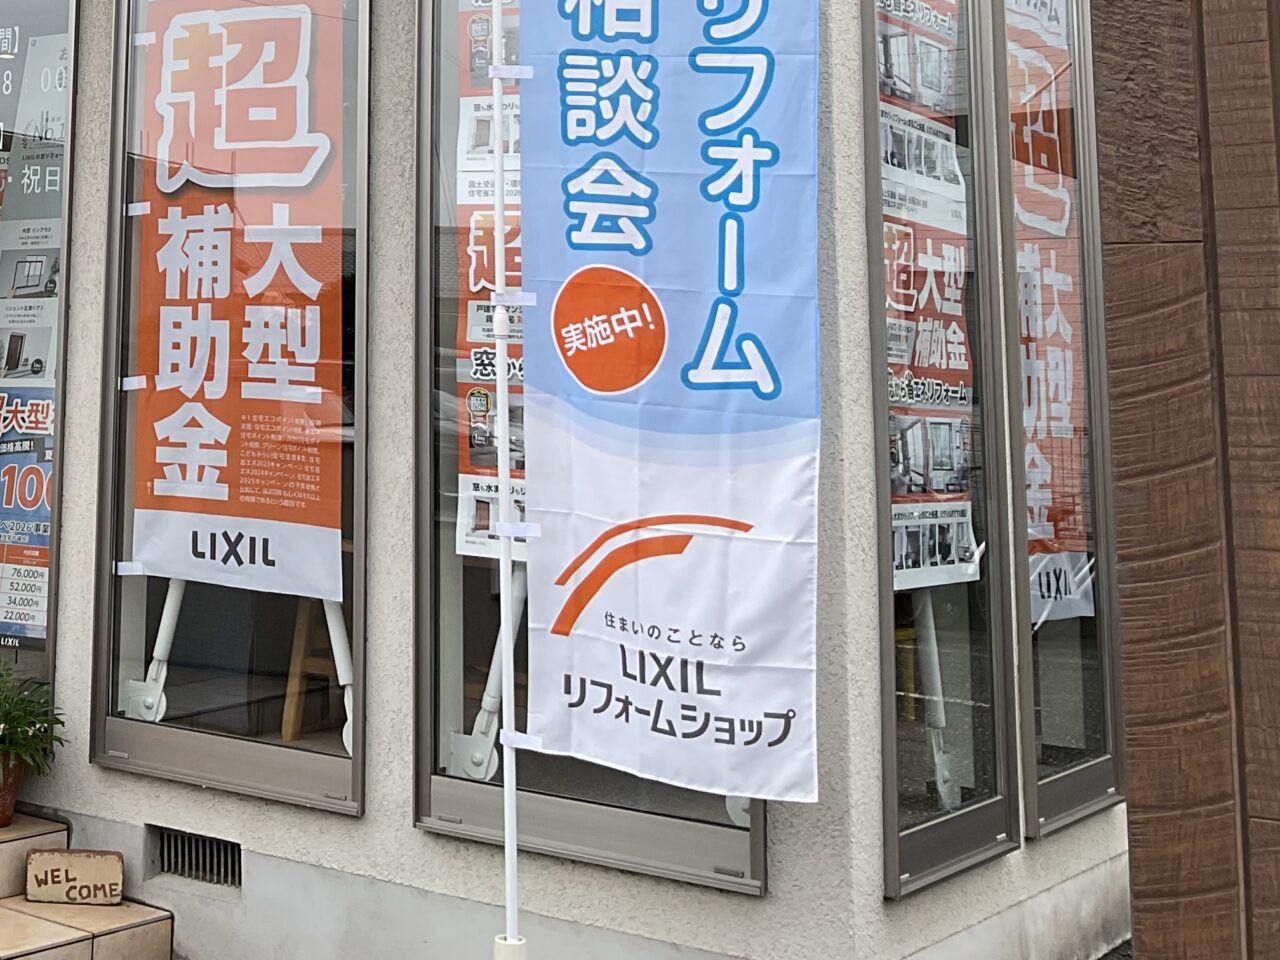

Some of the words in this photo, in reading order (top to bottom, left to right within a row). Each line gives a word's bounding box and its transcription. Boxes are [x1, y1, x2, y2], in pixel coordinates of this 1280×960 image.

[154, 4, 332, 194] 超
[884, 221, 965, 317] 超大型
[239, 203, 324, 404] 大型
[560, 303, 657, 358] 実施中!
[153, 203, 235, 501] 補助金
[915, 316, 969, 370] 補助金
[1043, 249, 1074, 439] 大型
[190, 529, 276, 567] LIXIL
[0, 637, 20, 647] LIXIL
[604, 611, 747, 653] 住まいのことなら
[620, 643, 722, 697] LIXIL
[563, 673, 797, 748] リフォームショップ
[34, 868, 77, 888] WEL
[65, 882, 121, 902] COME
